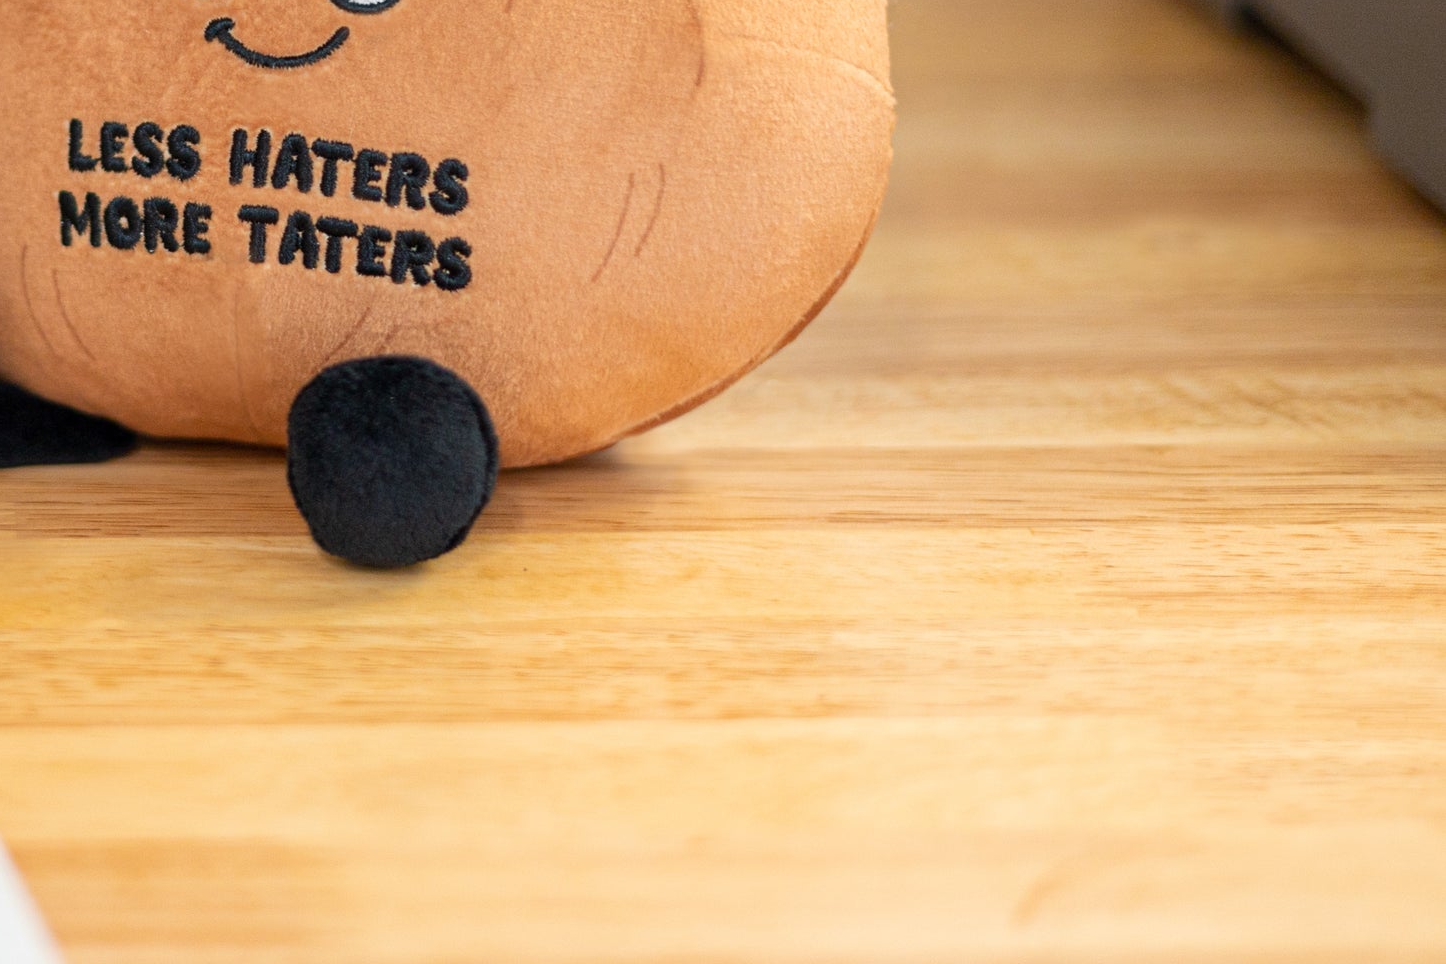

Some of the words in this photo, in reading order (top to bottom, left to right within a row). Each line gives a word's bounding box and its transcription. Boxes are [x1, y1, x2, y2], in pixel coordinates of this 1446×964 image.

[68, 118, 202, 182] LESS
[228, 128, 470, 216] HATERS
[58, 190, 213, 255] MORE
[237, 204, 473, 292] TATERS
